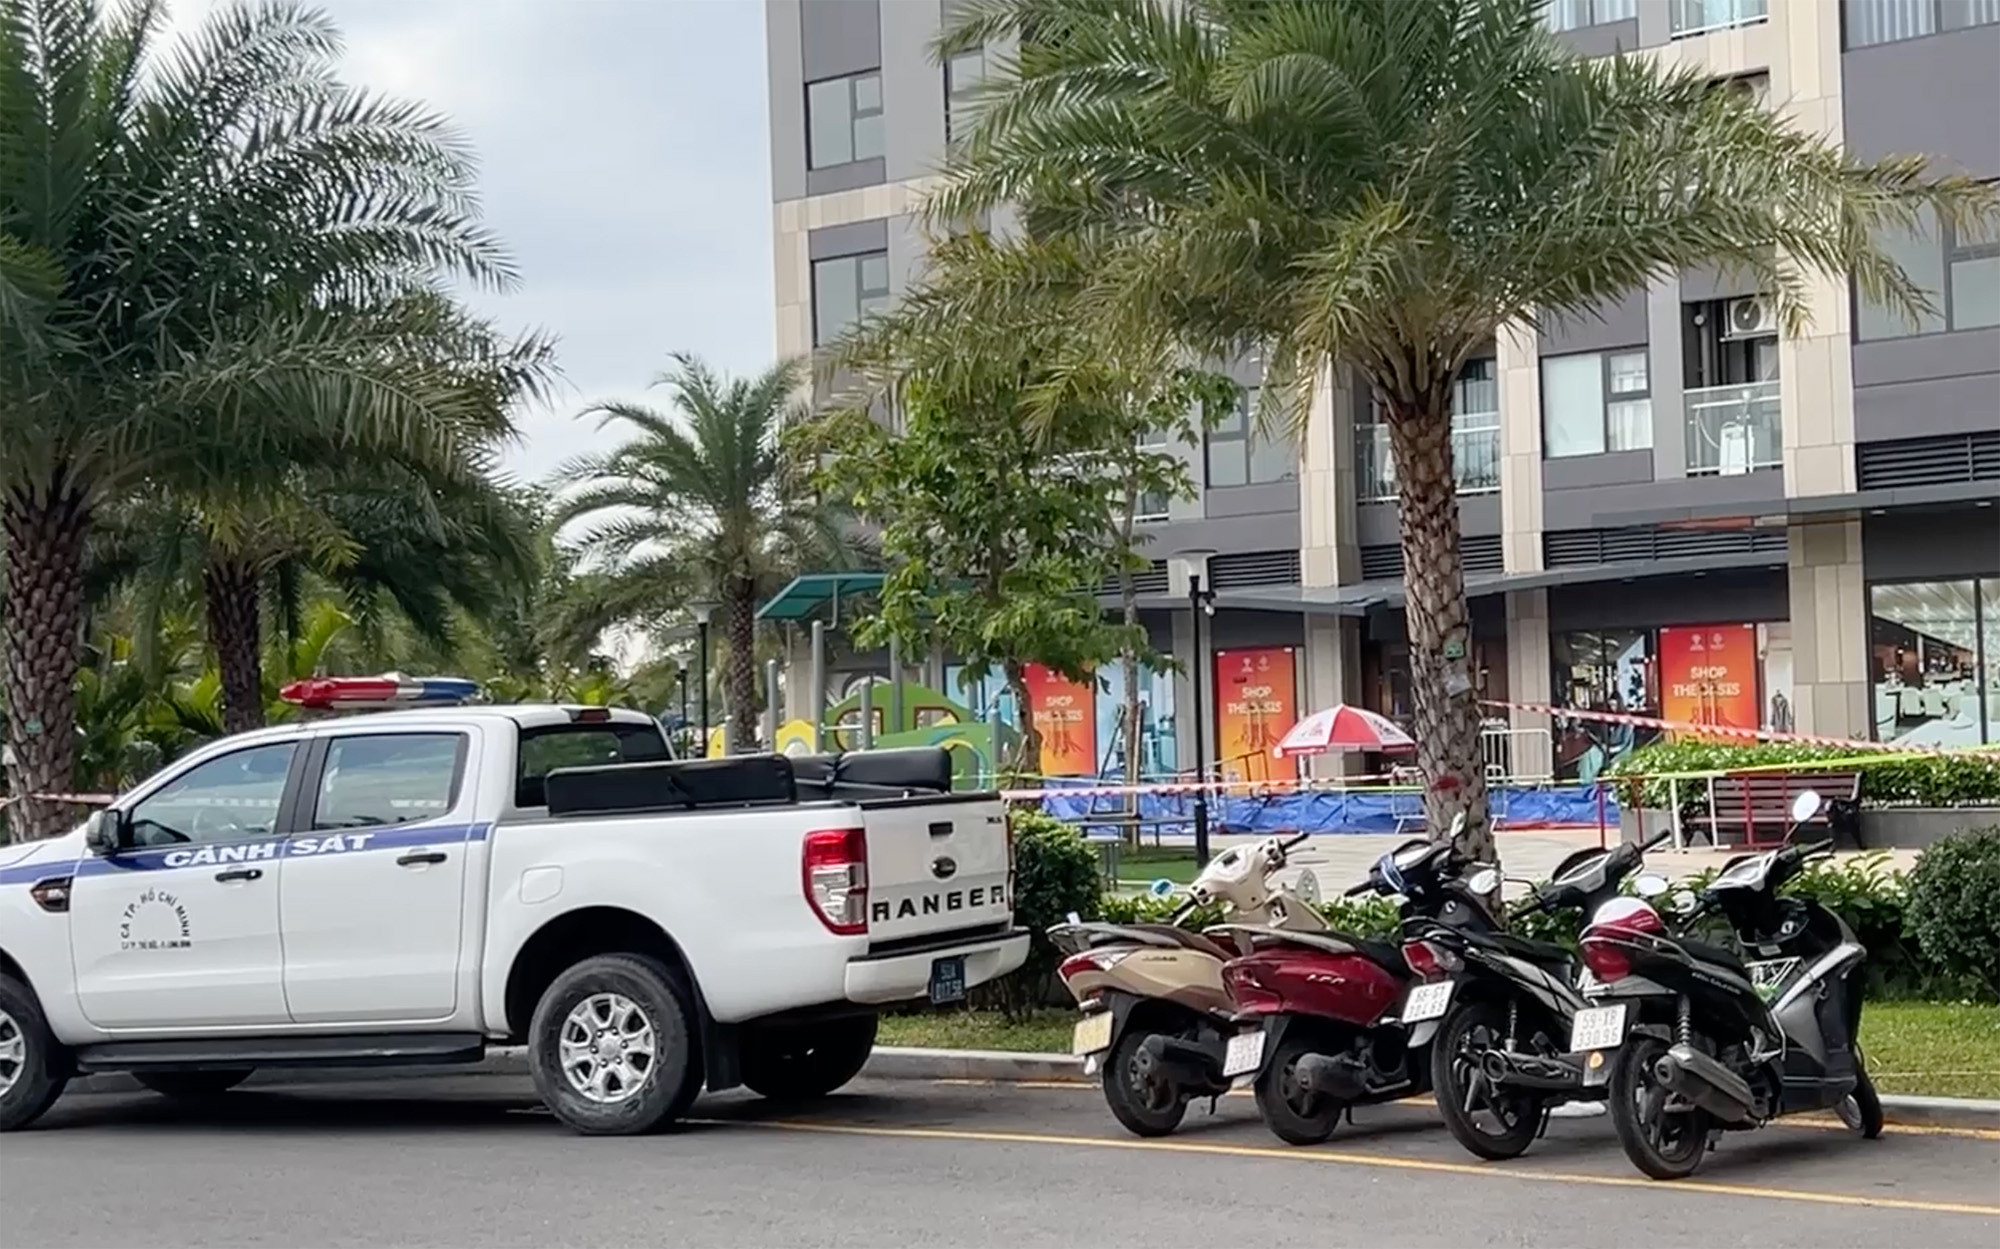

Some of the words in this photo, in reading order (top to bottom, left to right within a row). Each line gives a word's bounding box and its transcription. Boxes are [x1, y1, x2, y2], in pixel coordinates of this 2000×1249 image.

[1690, 666, 1728, 680] SHOP
[1242, 686, 1272, 699] SHOP
[1672, 683, 1697, 697] THE
[1045, 695, 1074, 707] SHOP
[163, 841, 275, 867] CẢNH
[290, 833, 375, 855] SÁT
[872, 886, 1005, 922] RANGER
[120, 923, 130, 939] CA
[174, 904, 190, 937] MINH
